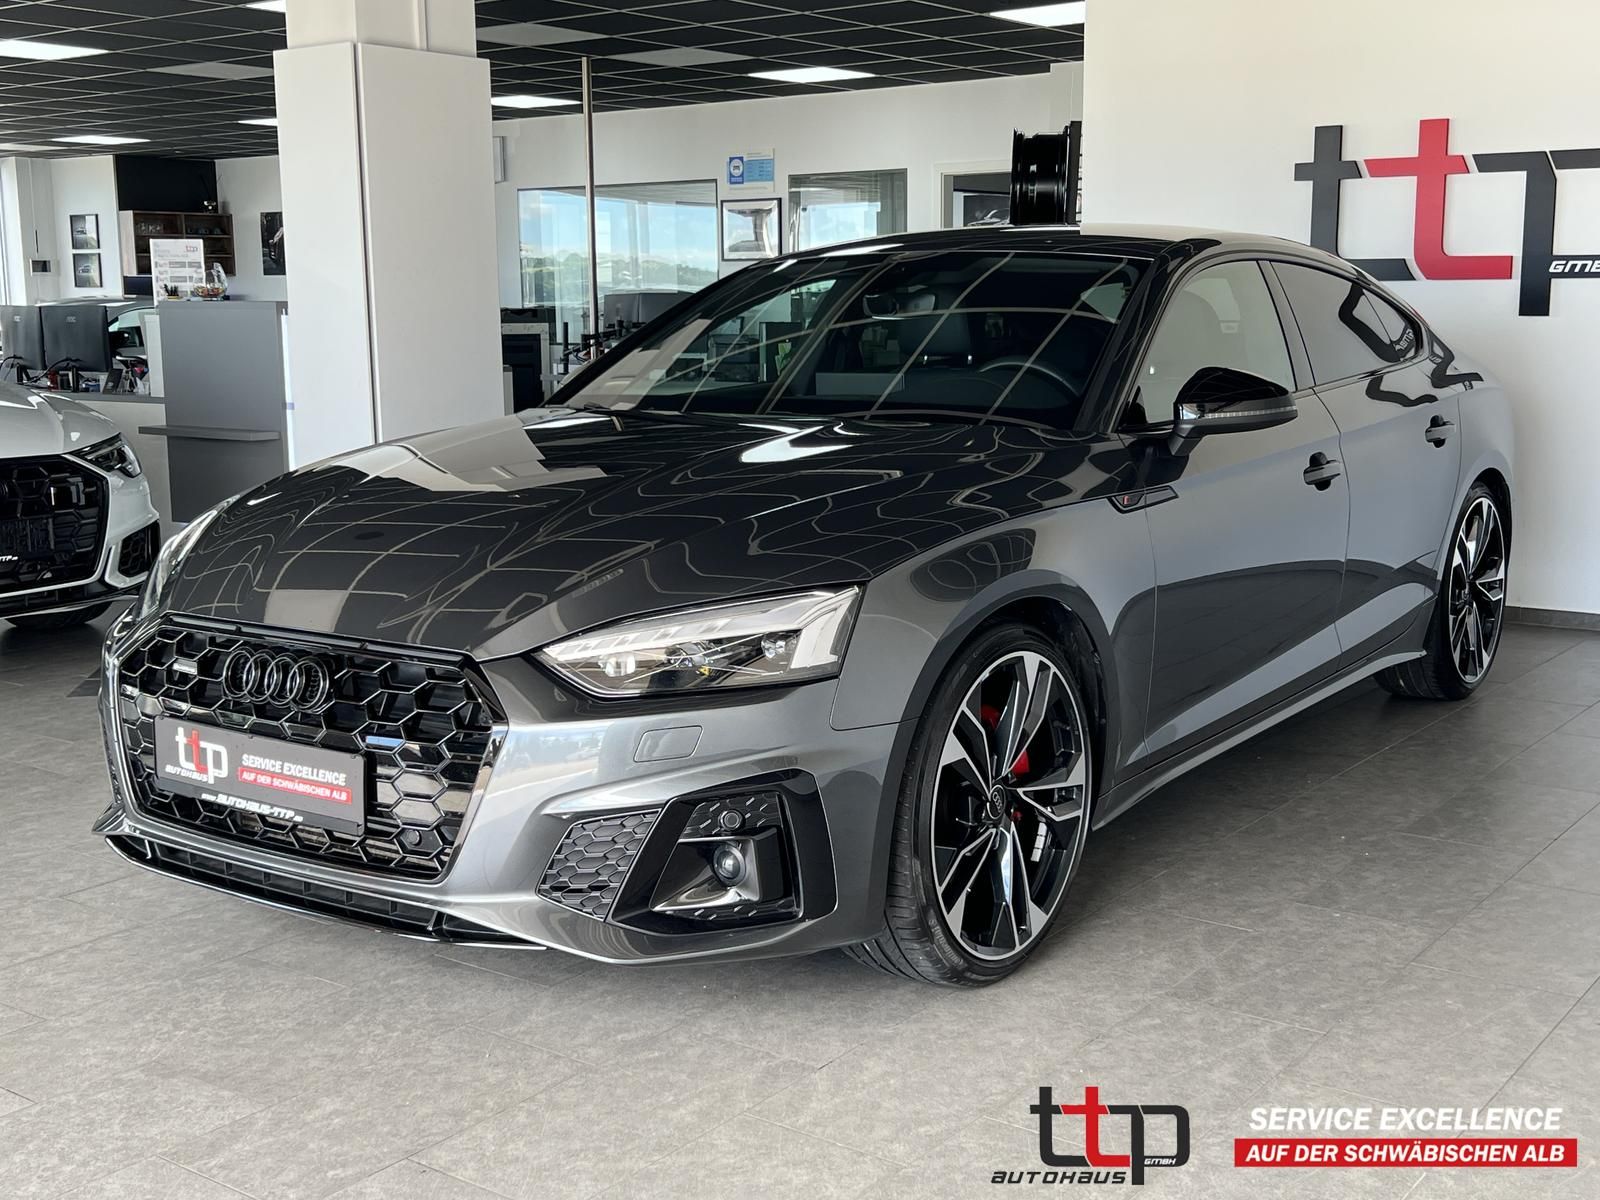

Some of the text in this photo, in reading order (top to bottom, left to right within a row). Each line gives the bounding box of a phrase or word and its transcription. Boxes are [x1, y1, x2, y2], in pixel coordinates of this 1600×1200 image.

[165, 763, 209, 782] AUTOHAUS
[242, 753, 347, 787] SERVICE EXCELLENCE
[242, 770, 257, 781] AUF
[256, 774, 272, 785] DER
[331, 790, 348, 801] ALB
